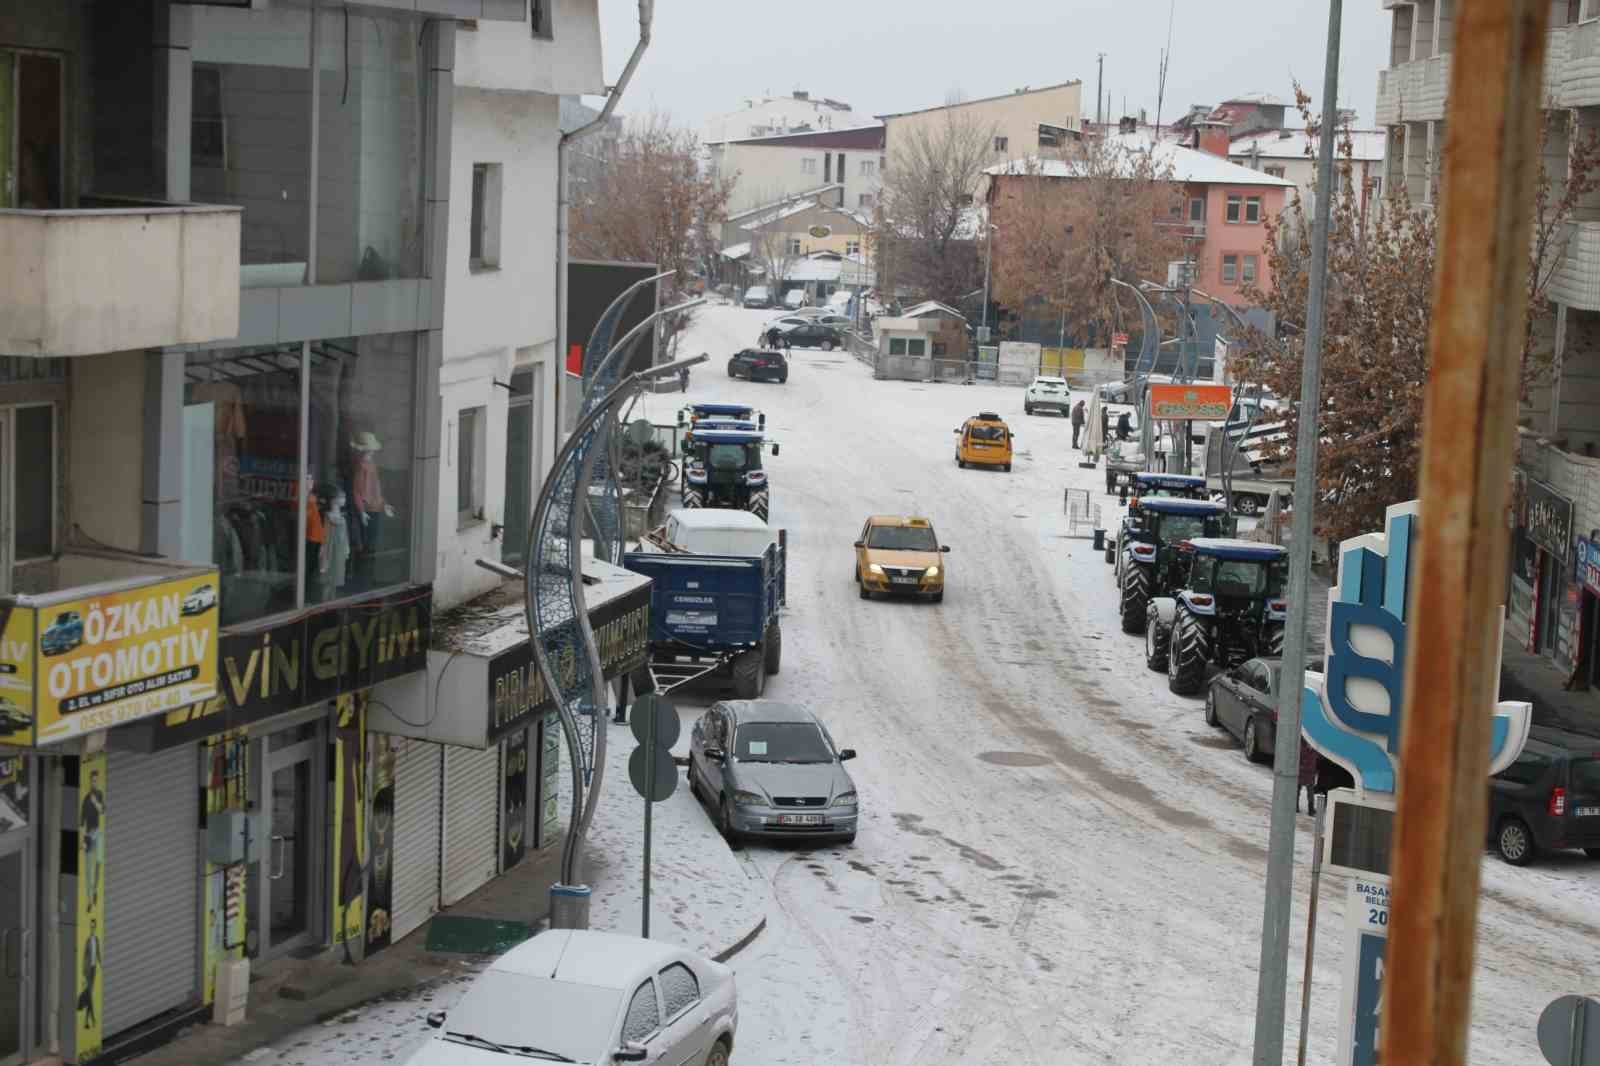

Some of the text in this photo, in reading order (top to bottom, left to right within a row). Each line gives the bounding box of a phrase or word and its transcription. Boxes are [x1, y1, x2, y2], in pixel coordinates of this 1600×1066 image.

[85, 593, 180, 645] ÖZKAN
[48, 626, 209, 698] OTOMOTİV
[127, 682, 144, 694] OTO
[1369, 909, 1390, 926] 20
